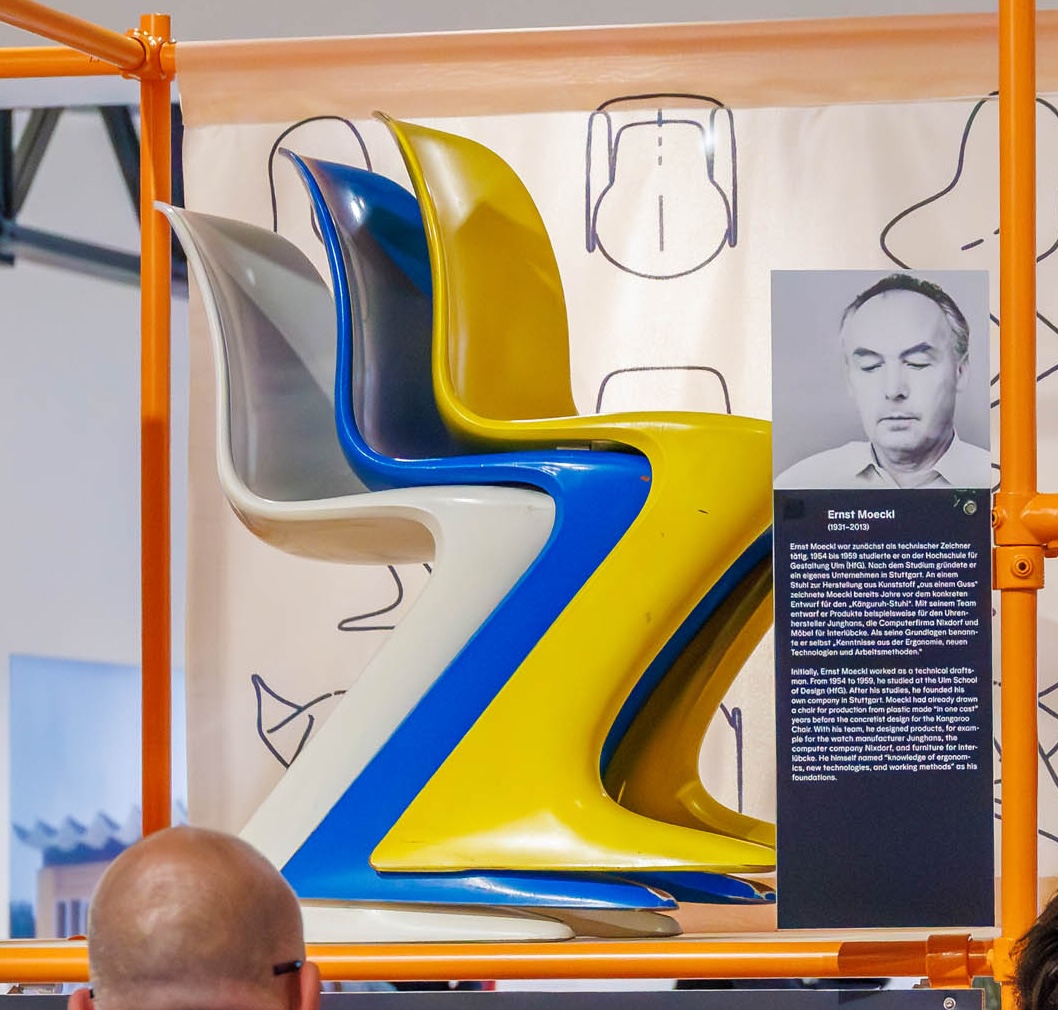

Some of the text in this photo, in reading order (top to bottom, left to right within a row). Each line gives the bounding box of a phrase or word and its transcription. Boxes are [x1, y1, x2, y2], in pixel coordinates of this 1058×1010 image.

[827, 510, 895, 519] Ernst Moeckl
[810, 552, 827, 560] 1954
[790, 561, 968, 571] Gestaltung Studium gründete
[802, 572, 830, 580] eigenes
[790, 581, 810, 589] Stuhl
[822, 581, 863, 590] Herstellung
[790, 600, 820, 608] Entwurf
[863, 610, 916, 618] beispielsweise
[878, 619, 935, 627] Computerfirma
[790, 629, 814, 637] Möbel
[904, 628, 947, 637] Grundlagen
[791, 648, 838, 657] Technologien
[841, 667, 868, 675] Moeckl
[869, 667, 897, 675] worked
[829, 677, 846, 685] 1954
[953, 676, 978, 684] School
[800, 687, 825, 696] Design
[927, 696, 955, 704] already
[886, 706, 911, 714] plastic
[791, 717, 811, 725] years
[886, 715, 910, 724] design
[935, 715, 970, 724] Kangaroo
[876, 725, 909, 734] designed
[791, 745, 827, 753] computer
[889, 763, 918, 772] working
